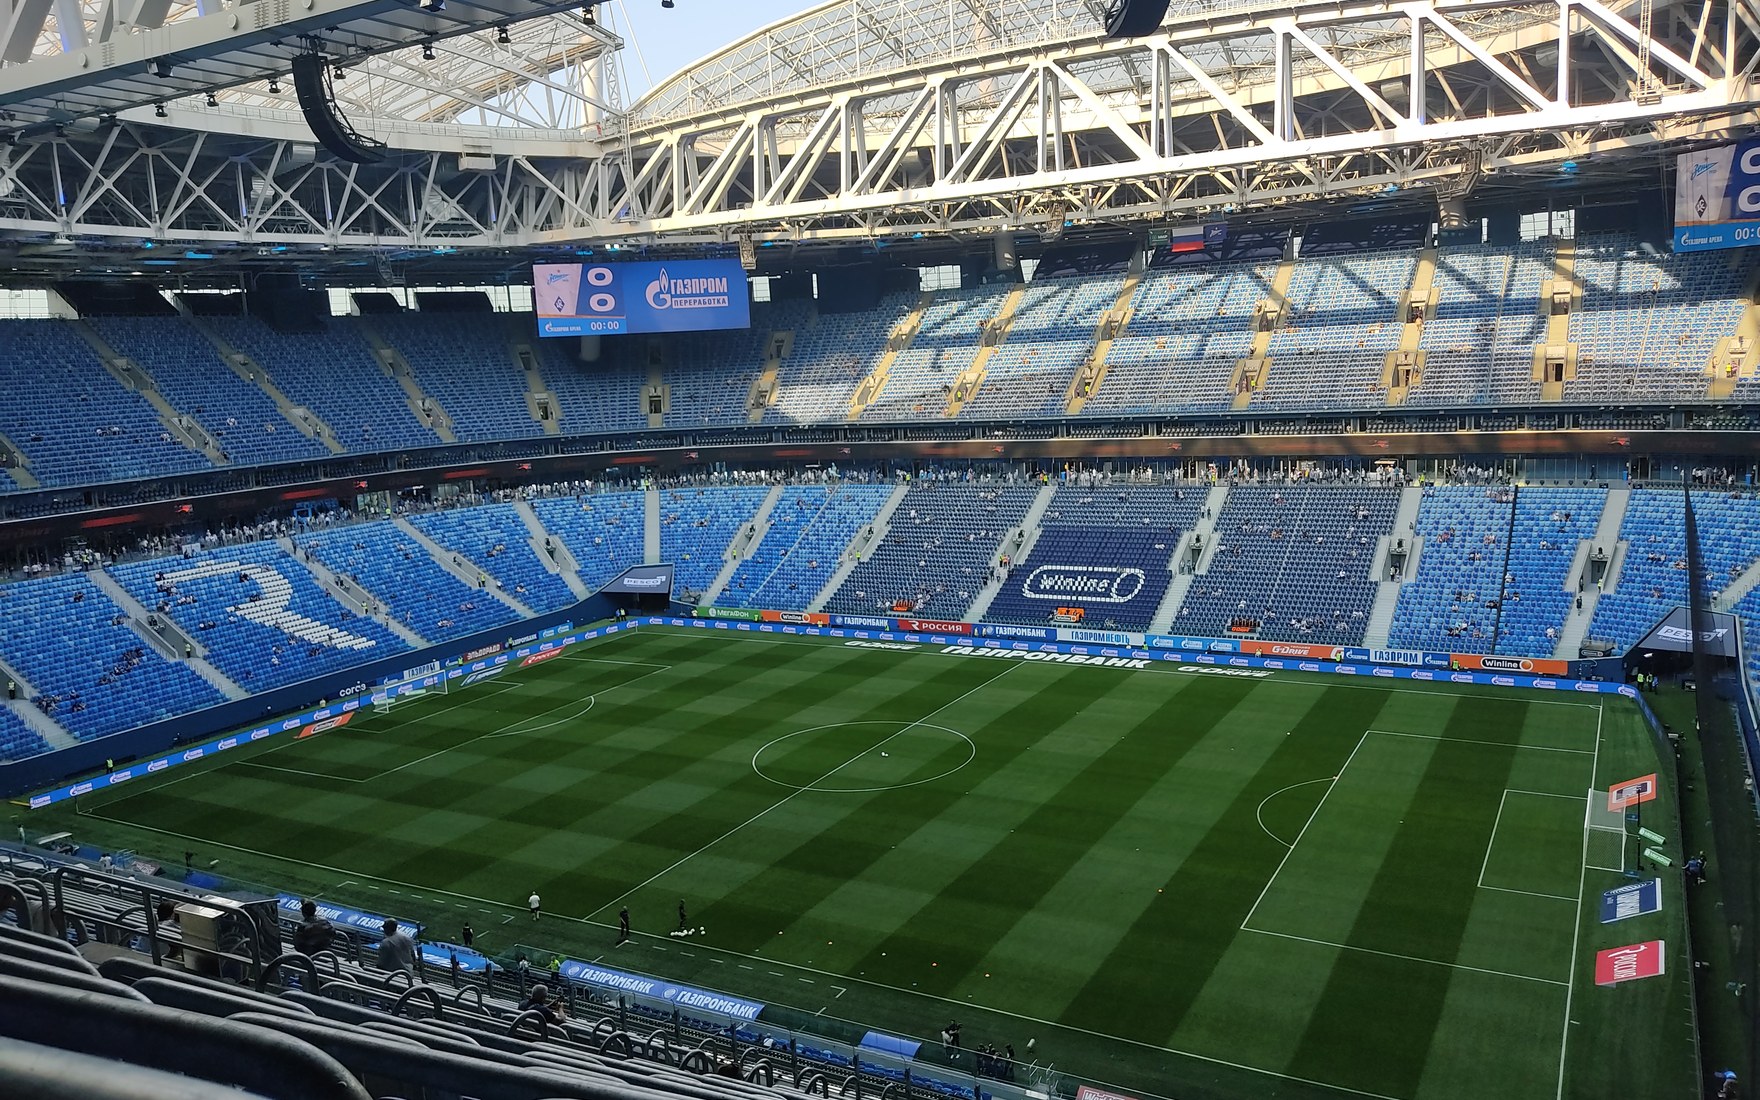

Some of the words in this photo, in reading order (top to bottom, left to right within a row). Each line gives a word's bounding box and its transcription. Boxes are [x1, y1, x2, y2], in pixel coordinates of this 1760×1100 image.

[587, 267, 613, 287] 0
[670, 277, 728, 296] ГАЗПРОМ
[589, 293, 616, 312] 0
[673, 297, 727, 308] ПЕРЕРАБОТКА
[590, 320, 620, 331] 00:00
[844, 616, 889, 627] ГАЗПРОМБАНК
[922, 622, 962, 632] РОССИЯ
[995, 626, 1047, 638] ГАЗПРОМБАНК
[1071, 630, 1130, 644] ГАЗПРОМНЕФТЬ
[1664, 628, 1712, 640] PESO
[466, 643, 501, 661] ЭЛЬДОРАДО
[940, 645, 1152, 669] ГАЗПРОМБАНК
[1374, 649, 1418, 664] ГАЗПРОМ
[1485, 659, 1519, 669] Winline
[579, 967, 656, 994] ГАЗПРОМБАНК
[676, 990, 758, 1019] ГАЗПРОМБАНК
